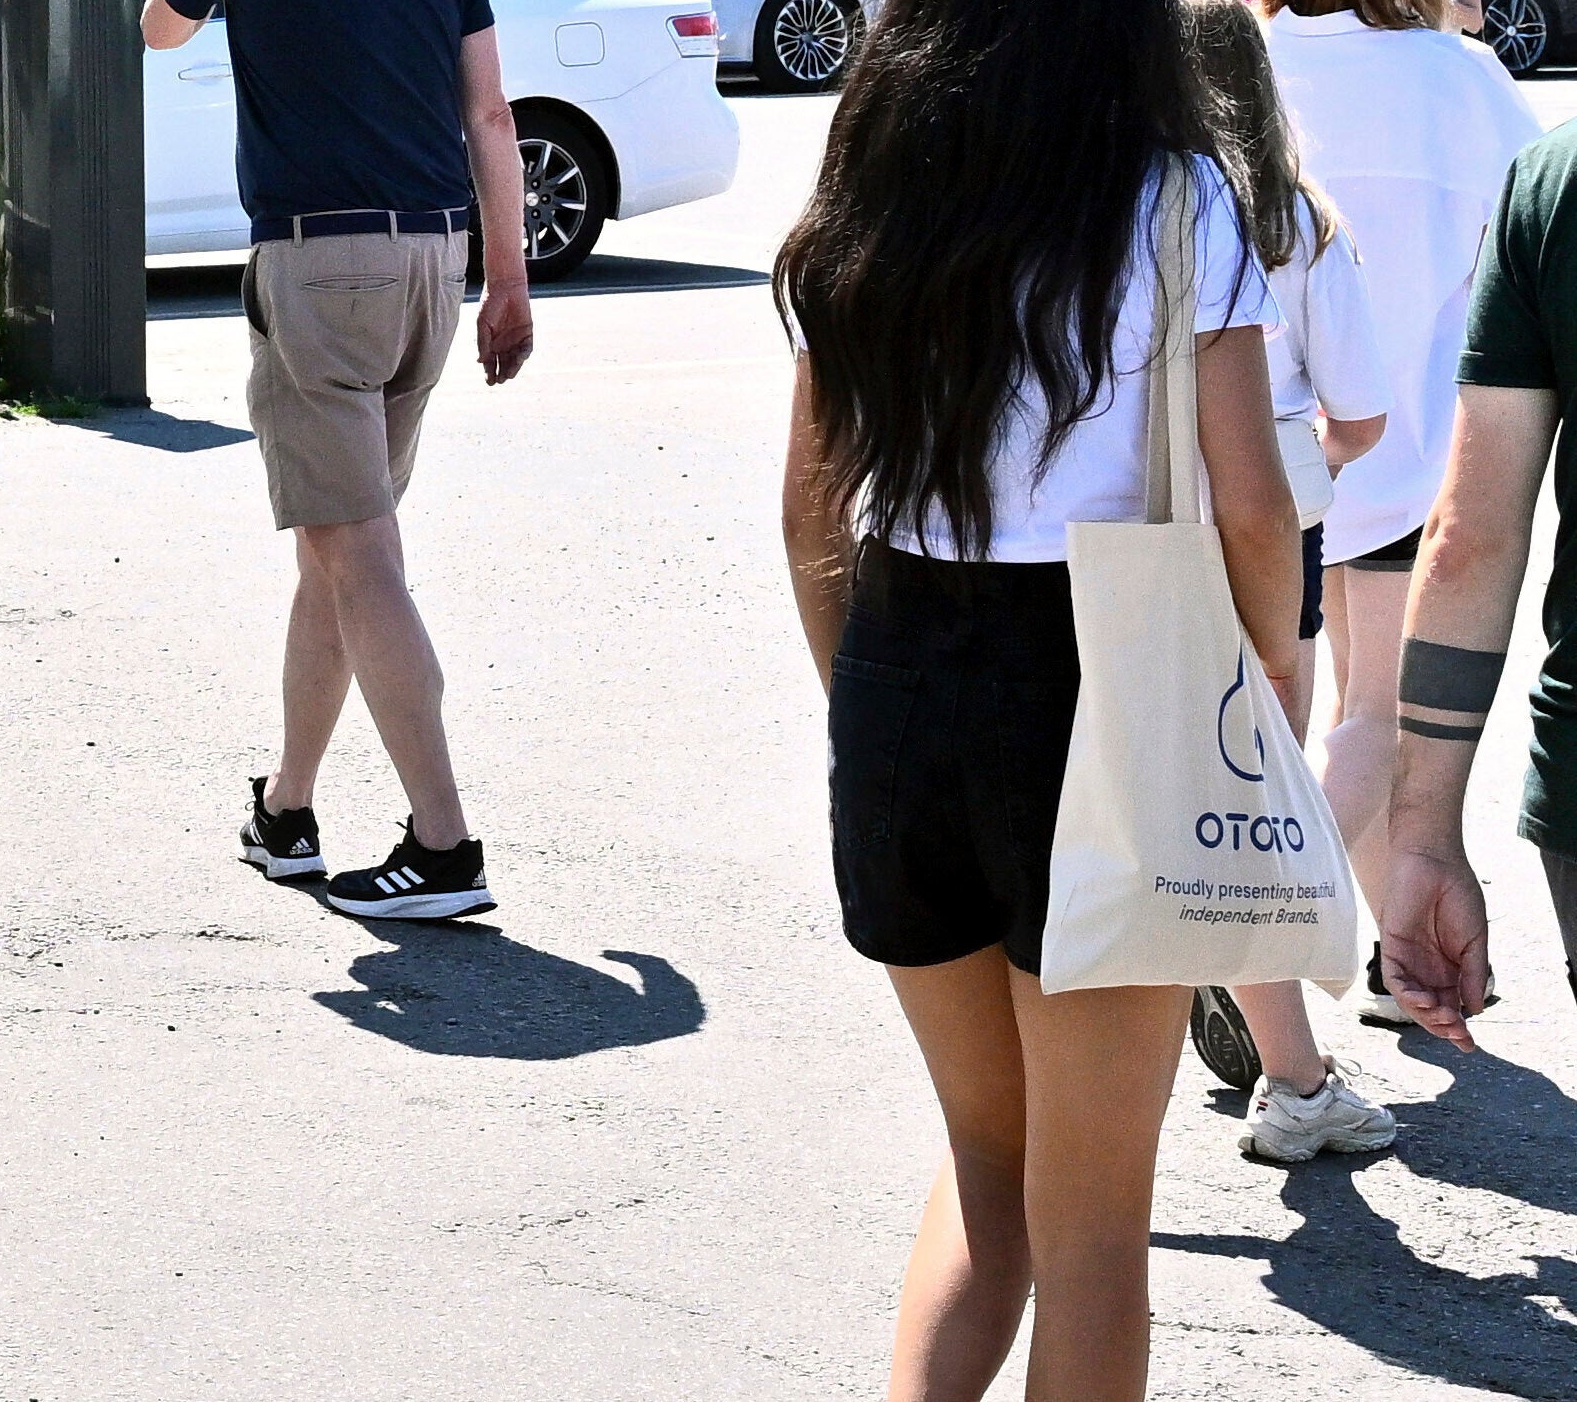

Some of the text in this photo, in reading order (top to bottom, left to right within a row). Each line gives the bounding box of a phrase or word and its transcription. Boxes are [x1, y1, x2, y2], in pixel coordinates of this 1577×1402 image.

[1195, 812, 1305, 853] OTOTO
[1155, 876, 1336, 903] Proudly presenting beatiful
[1179, 904, 1319, 925] independent Brands.
